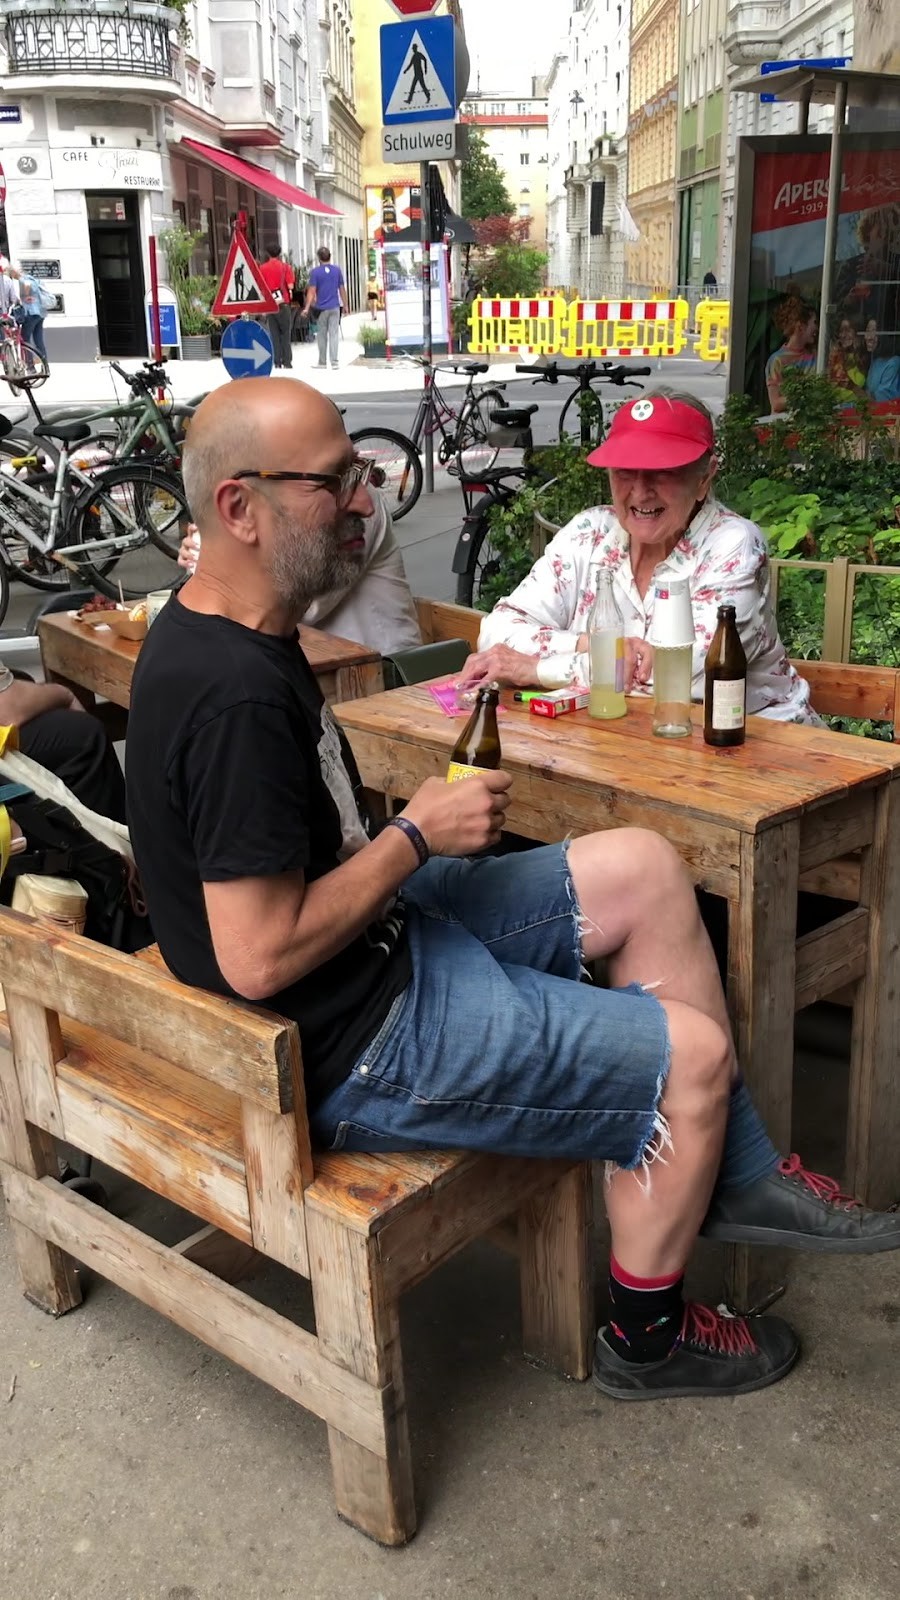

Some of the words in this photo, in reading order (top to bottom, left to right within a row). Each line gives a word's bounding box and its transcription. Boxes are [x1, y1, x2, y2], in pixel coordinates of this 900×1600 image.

[384, 131, 452, 152] Schulweg
[62, 151, 89, 162] CAFE
[800, 201, 825, 216] 1919
